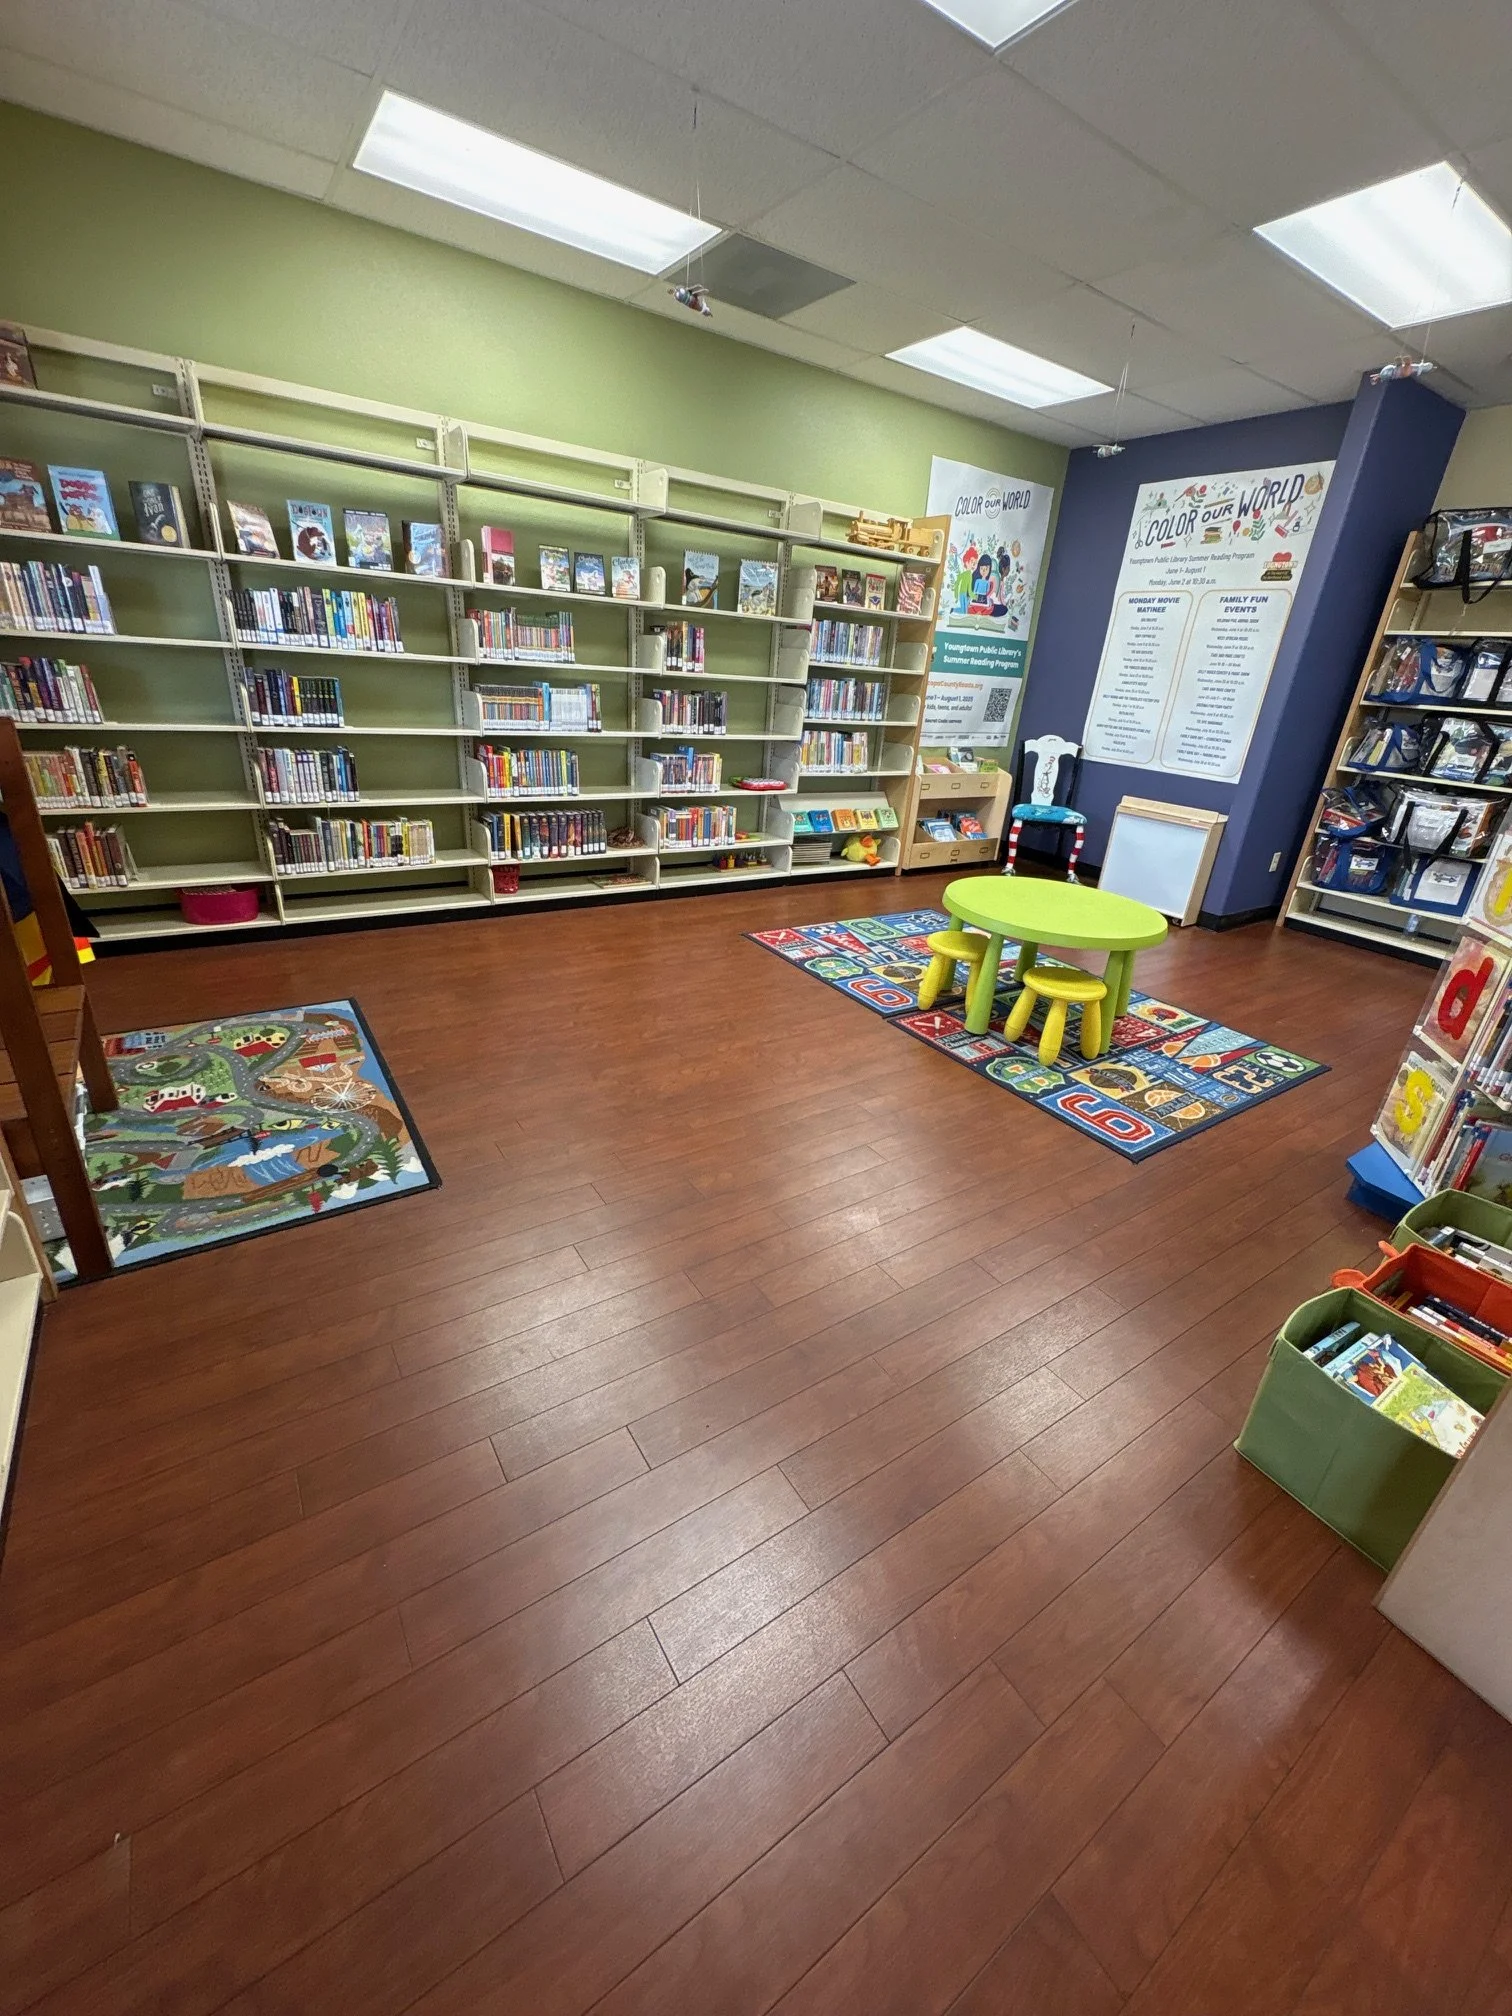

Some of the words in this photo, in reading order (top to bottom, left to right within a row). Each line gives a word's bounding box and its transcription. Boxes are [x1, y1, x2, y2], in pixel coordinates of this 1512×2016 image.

[954, 495, 984, 517] COLOR
[985, 498, 1001, 509] OUR
[1002, 489, 1031, 511] WORLD
[1145, 509, 1198, 547] COLOR
[1201, 503, 1234, 523] OUR
[1237, 473, 1305, 519] WORLD
[1129, 557, 1154, 566] Youngtown
[1170, 555, 1188, 564] Library
[1188, 555, 1209, 563] Summer
[1210, 553, 1231, 562] Reading
[1231, 552, 1255, 561] Program
[1165, 567, 1179, 575] June
[1185, 567, 1202, 575] August
[1168, 578, 1181, 586] June
[944, 642, 979, 653] Youngtown
[979, 645, 998, 655] Public
[998, 646, 1022, 658] Library's
[943, 655, 970, 665] Summer
[970, 657, 995, 668] Reading
[994, 659, 1019, 670] Program
